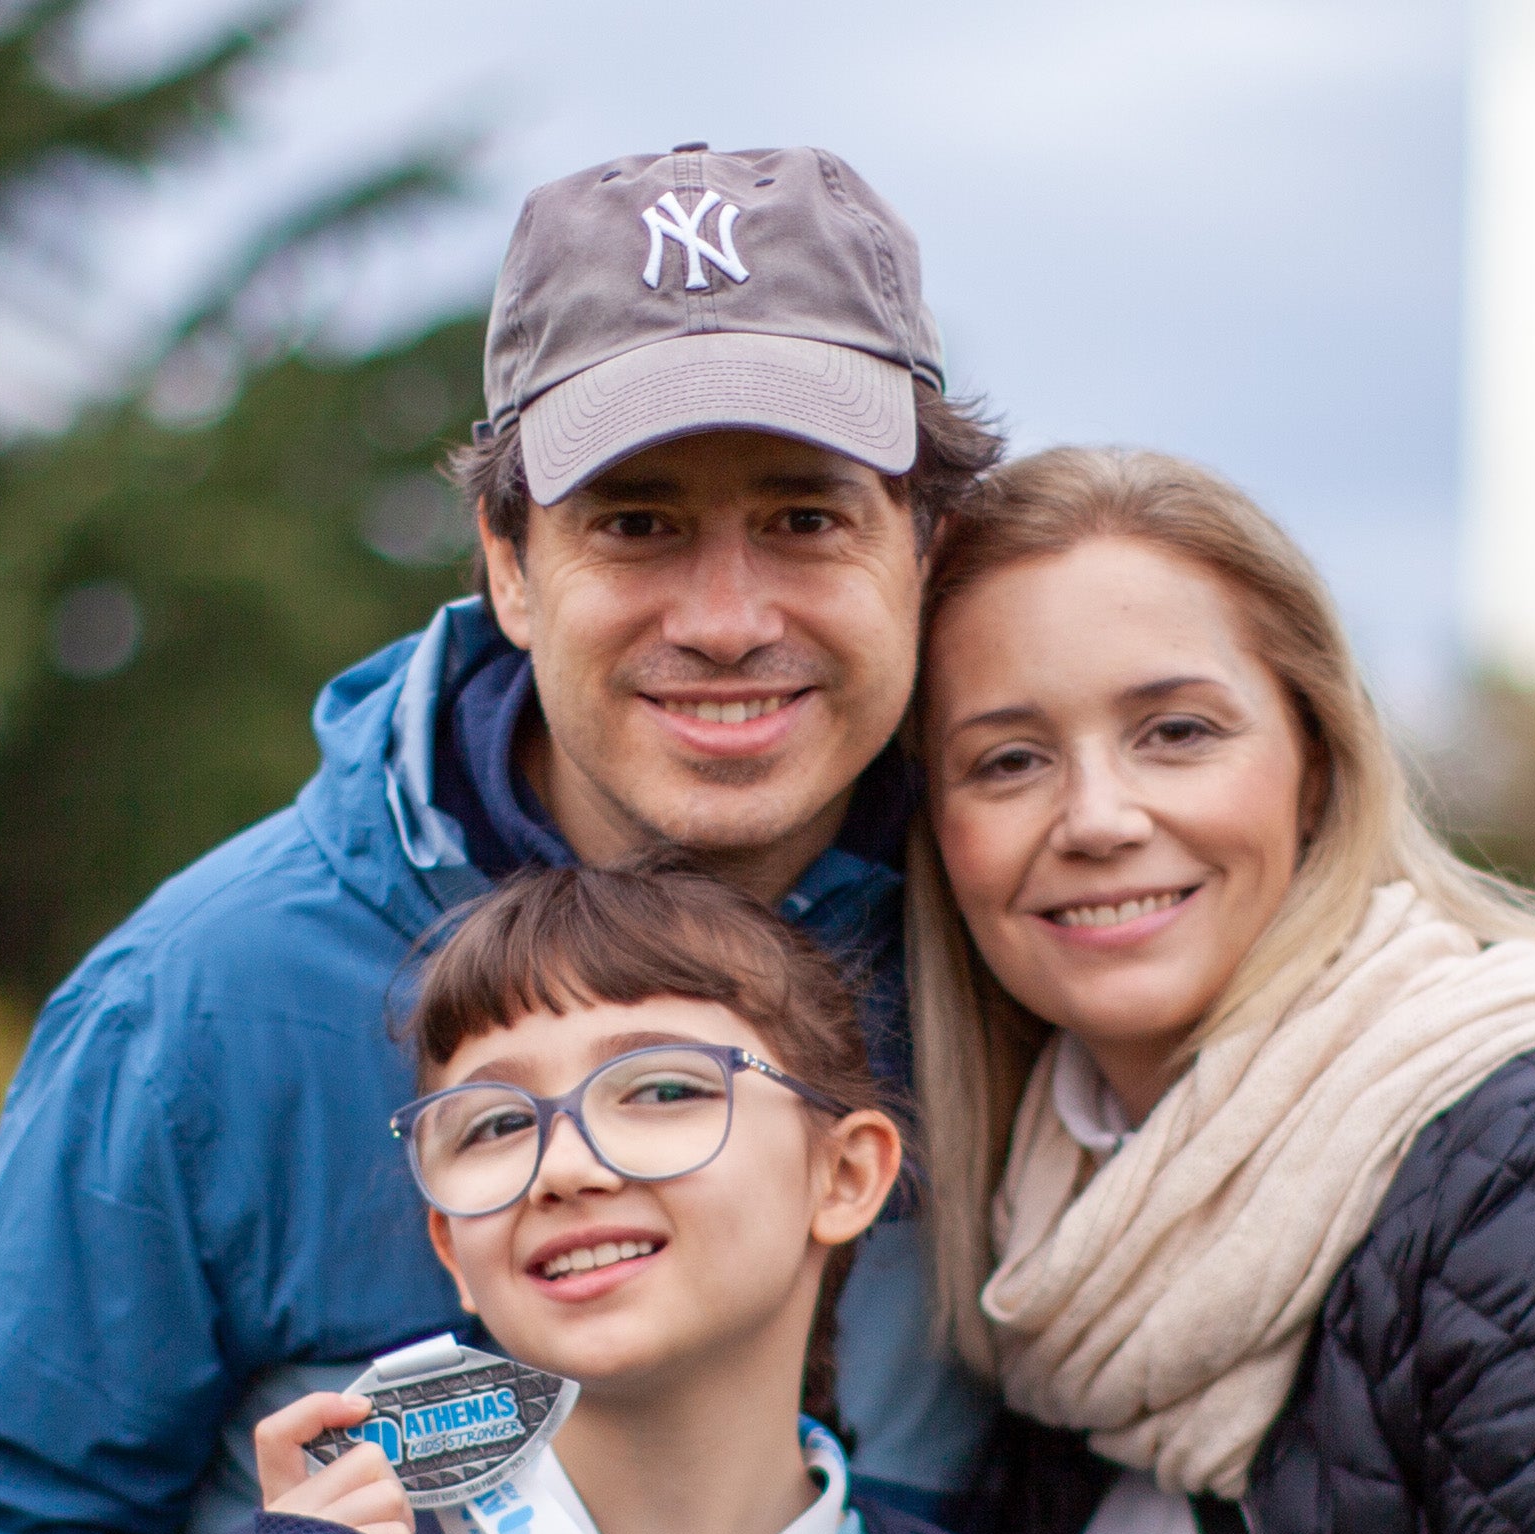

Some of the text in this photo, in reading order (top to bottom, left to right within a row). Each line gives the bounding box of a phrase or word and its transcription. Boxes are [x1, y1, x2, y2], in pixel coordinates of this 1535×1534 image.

[640, 190, 750, 290] NY
[405, 1391, 516, 1439] ATHENAS
[410, 1420, 523, 1457] KIDS STRONGER
